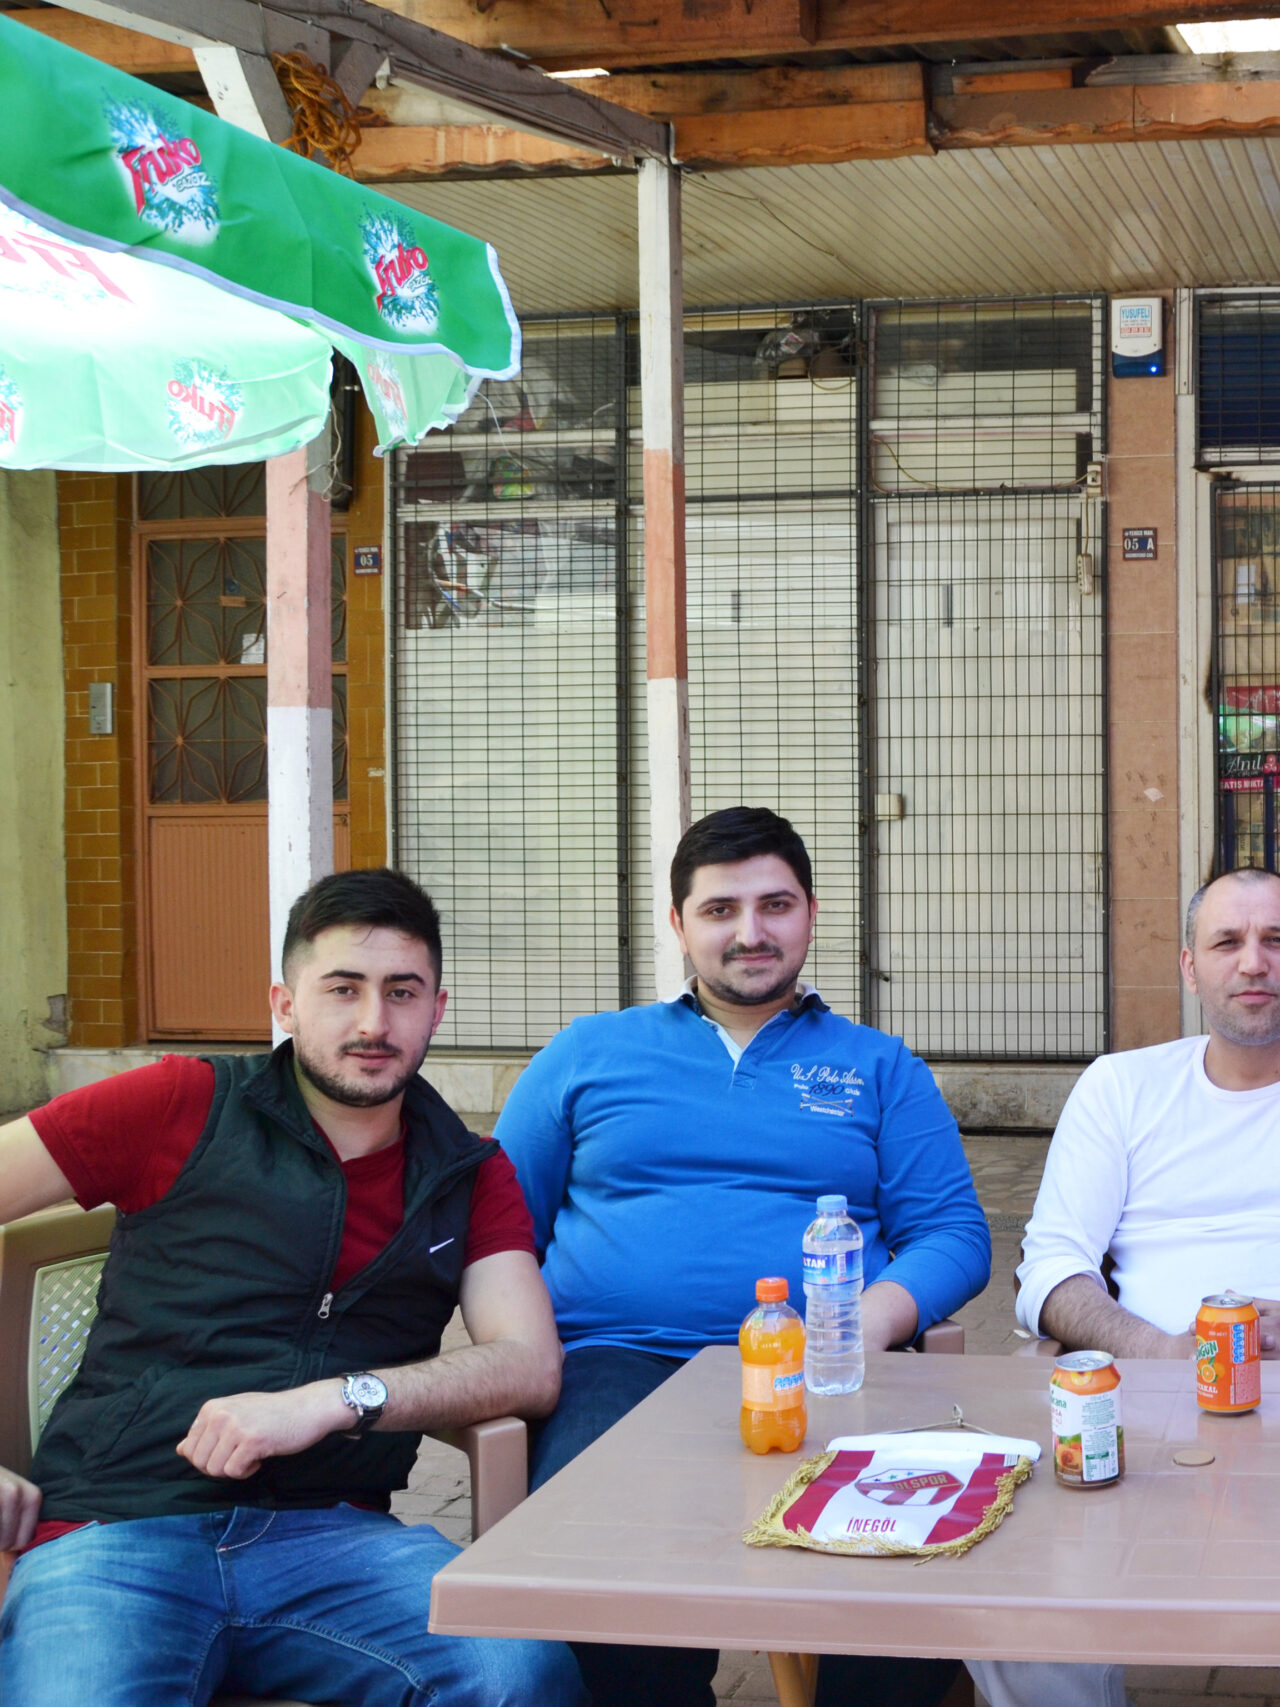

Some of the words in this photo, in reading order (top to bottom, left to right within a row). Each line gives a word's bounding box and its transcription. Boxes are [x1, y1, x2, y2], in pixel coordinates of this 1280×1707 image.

[121, 133, 202, 216] Fruko
[375, 242, 429, 313] Fruko
[1124, 538, 1139, 550] 05
[1147, 537, 1154, 550] A
[360, 554, 373, 567] 05
[817, 1066, 839, 1083] Polo
[809, 1081, 845, 1096] 1890
